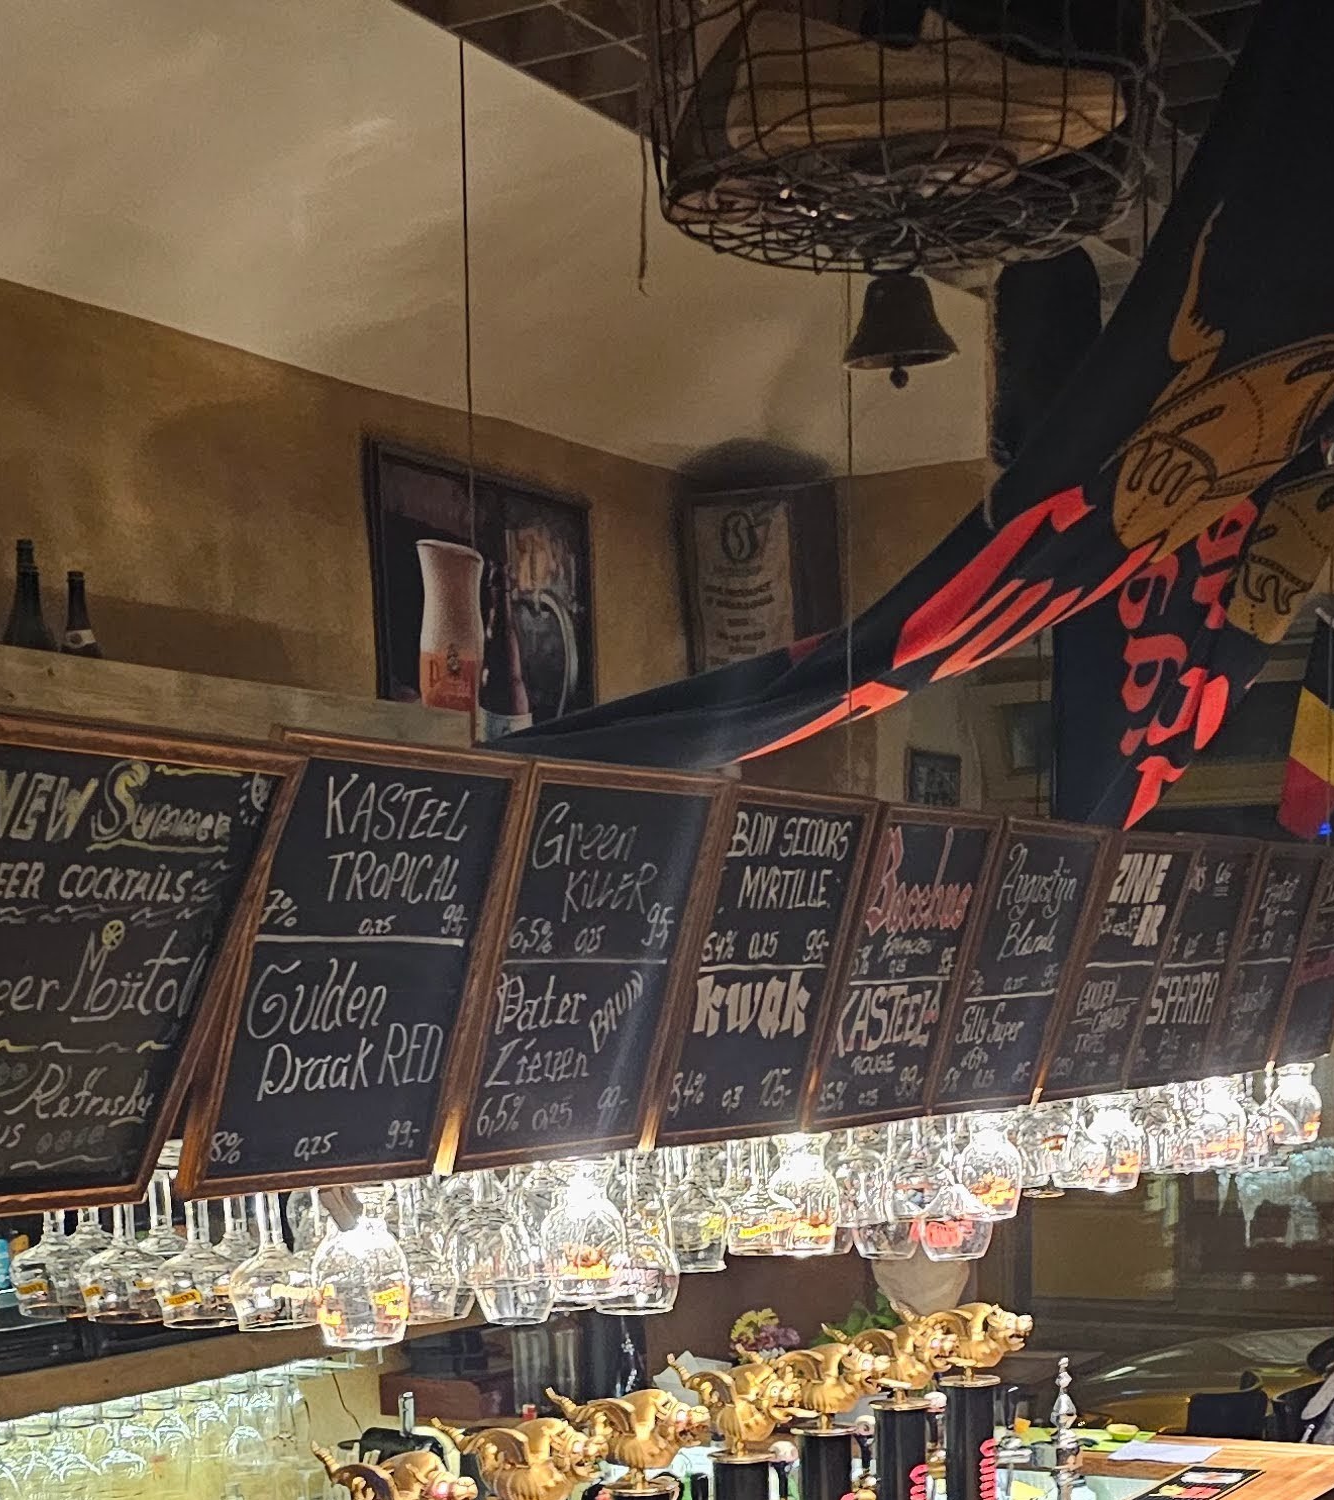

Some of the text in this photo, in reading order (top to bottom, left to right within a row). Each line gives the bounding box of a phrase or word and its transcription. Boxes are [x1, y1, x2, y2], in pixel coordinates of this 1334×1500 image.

[325, 773, 469, 842] KASTEEL
[532, 801, 641, 870] Green
[726, 811, 778, 858] BON
[327, 851, 460, 904] TROPICAL
[738, 865, 834, 910] MYRTILLE
[865, 825, 973, 936] Bacchus
[247, 958, 387, 1039] Gulden
[495, 973, 587, 1035] Pater
[377, 1023, 444, 1087] RED
[851, 1052, 896, 1076] ROUGE
[210, 1131, 244, 1164] 8%
